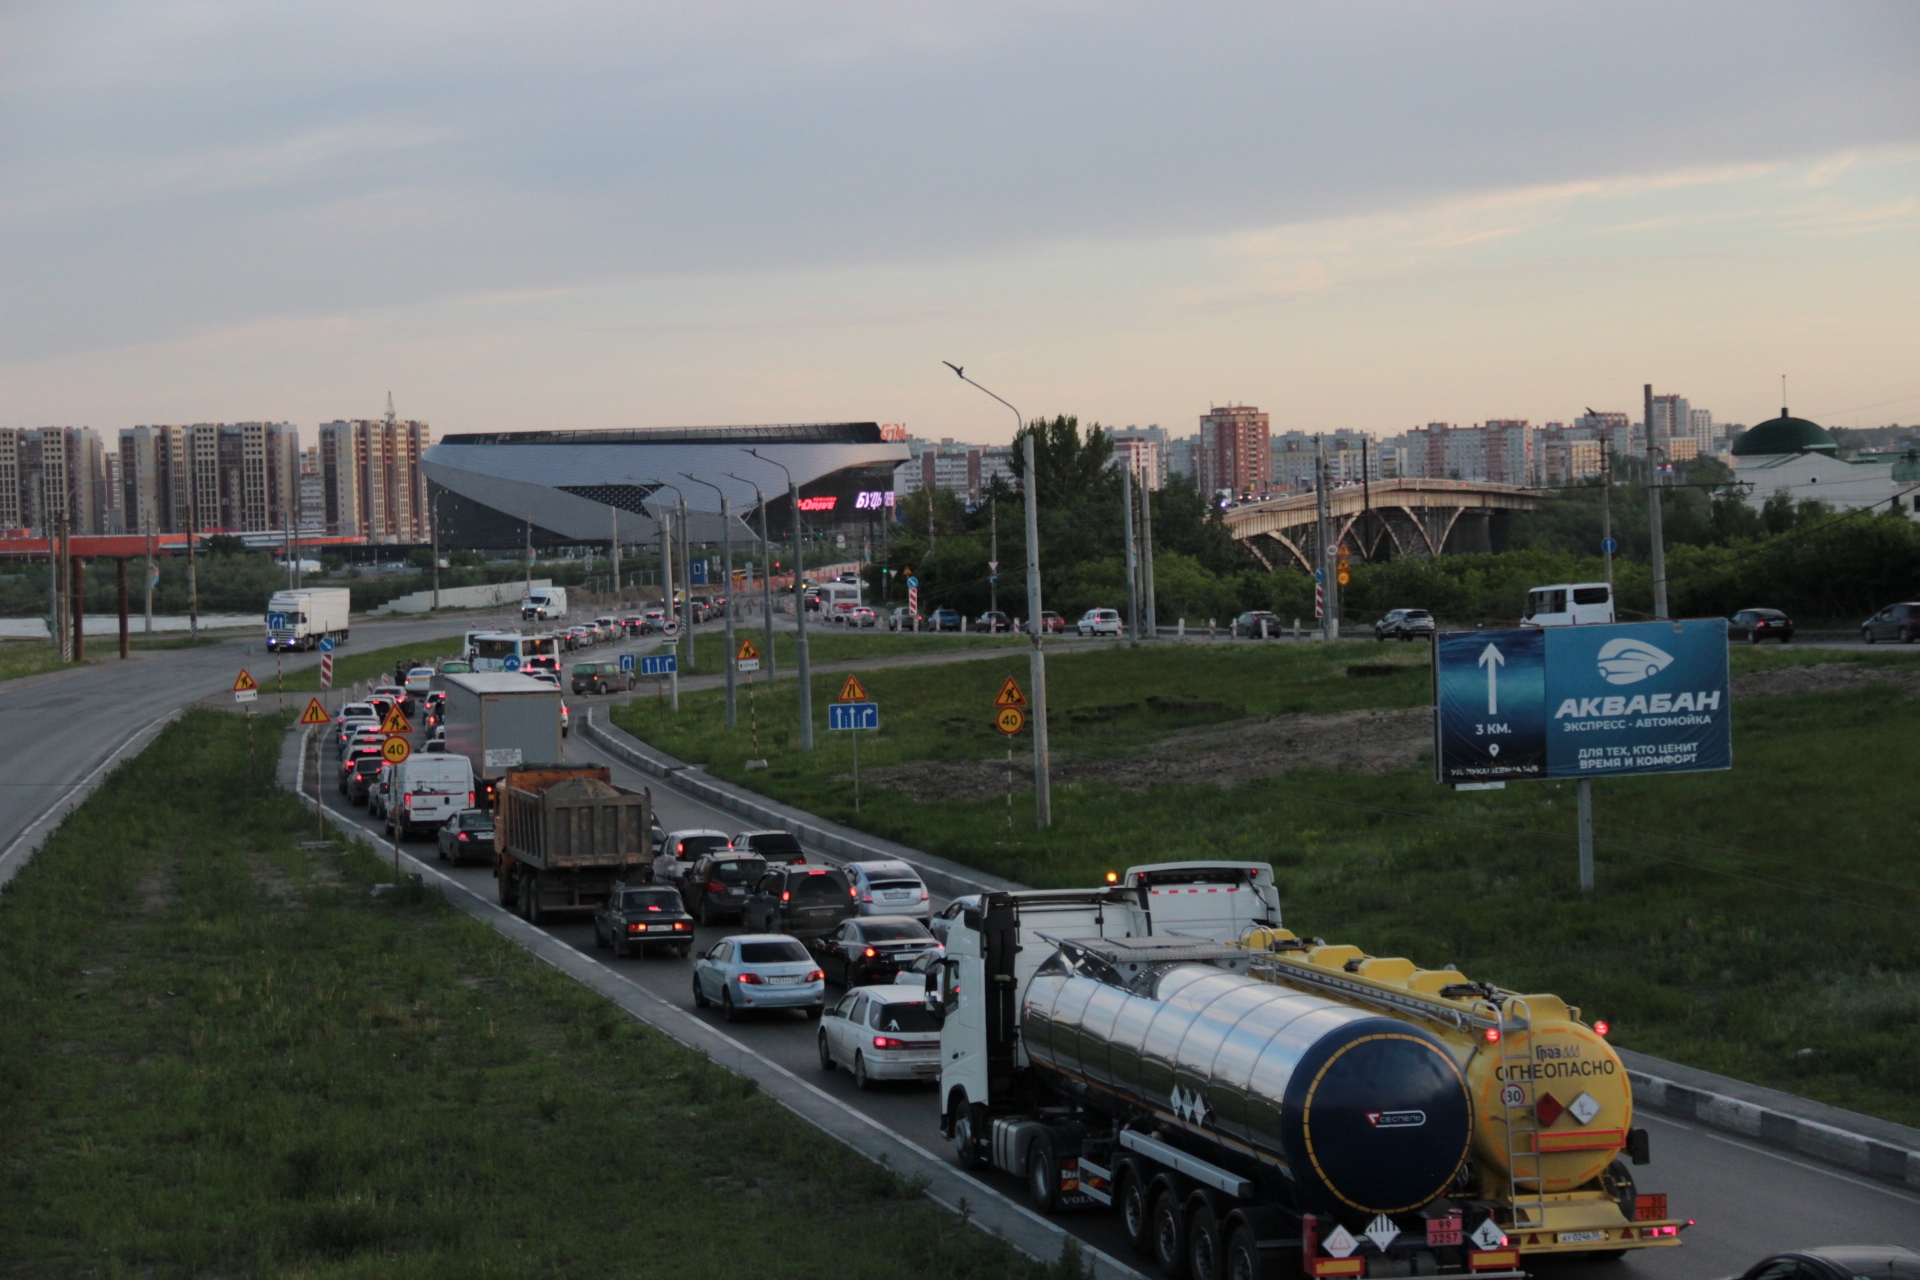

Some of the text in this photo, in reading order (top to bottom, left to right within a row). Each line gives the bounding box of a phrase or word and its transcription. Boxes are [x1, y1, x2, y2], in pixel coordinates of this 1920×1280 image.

[1554, 691, 1720, 719] АКВАБАН
[1002, 715, 1018, 726] 40
[1563, 720, 1626, 732] ЭКСПРЕСС
[1635, 714, 1712, 729] АВТОМОЙКА
[1475, 723, 1512, 735] 3 КМ.
[387, 743, 405, 756] 40
[1578, 742, 1699, 759] ДЛЯ ТЕХ, КТО ЦЕНИТ
[1580, 753, 1697, 769] ВРЕМЯ И КОМФОРТ
[1496, 1059, 1615, 1082] ОГНЕОПАСНО
[1062, 1195, 1096, 1205] VOLV
[1438, 1220, 1451, 1230] 99
[1432, 1233, 1458, 1244] 3257
